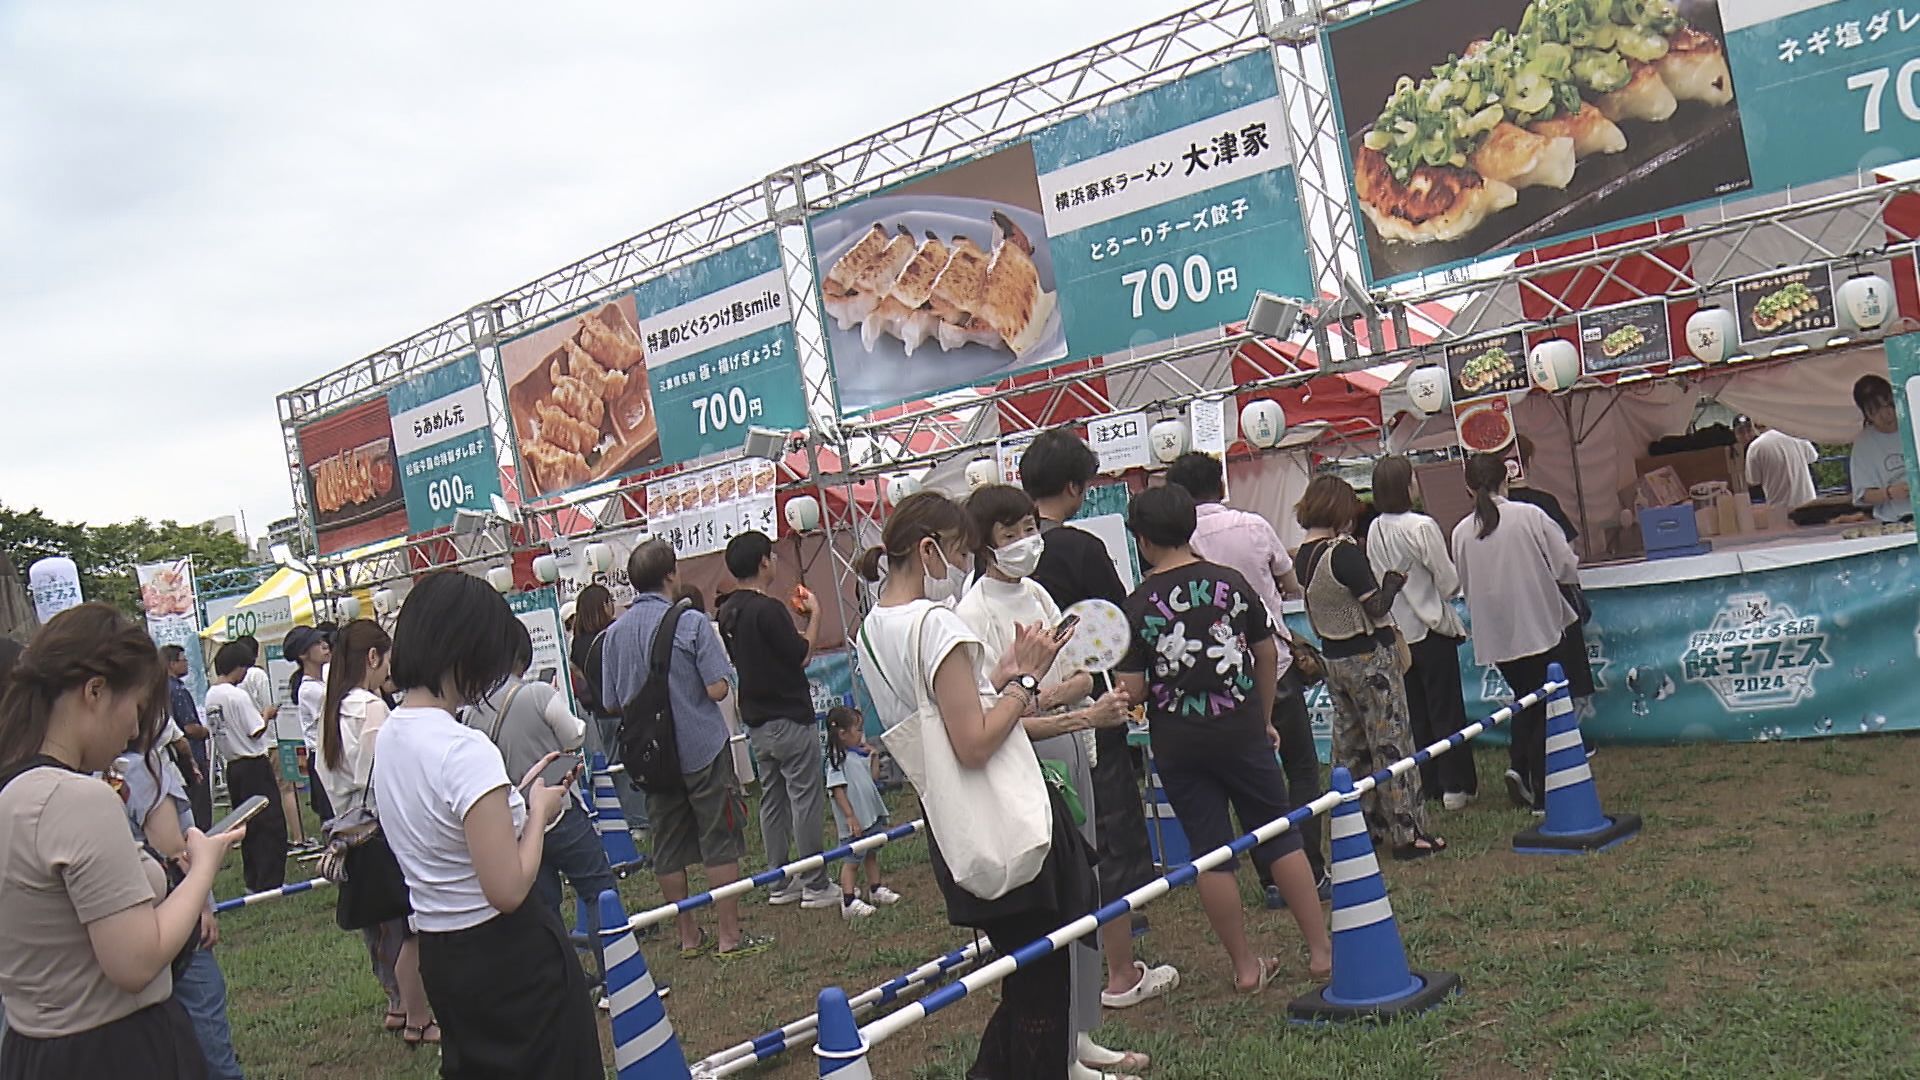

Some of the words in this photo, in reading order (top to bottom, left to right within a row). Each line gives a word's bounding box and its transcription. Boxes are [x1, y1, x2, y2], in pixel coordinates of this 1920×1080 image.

[1054, 160, 1174, 212] 横浜家系ラーメン
[1181, 121, 1271, 177] 大津家
[1090, 197, 1250, 261] とろーりチーズ餃子
[1121, 254, 1238, 319] 700円
[413, 404, 465, 438] らあめん元
[692, 387, 762, 435] 700円
[1096, 421, 1138, 443] 注文口
[428, 474, 474, 511] 600円
[652, 505, 774, 551] 揚げぎょうざ
[228, 611, 257, 640] ECO
[1692, 618, 1815, 647] 行列のできる名店
[1683, 637, 1829, 680] 餃子フェス
[1734, 675, 1784, 693] 2024
